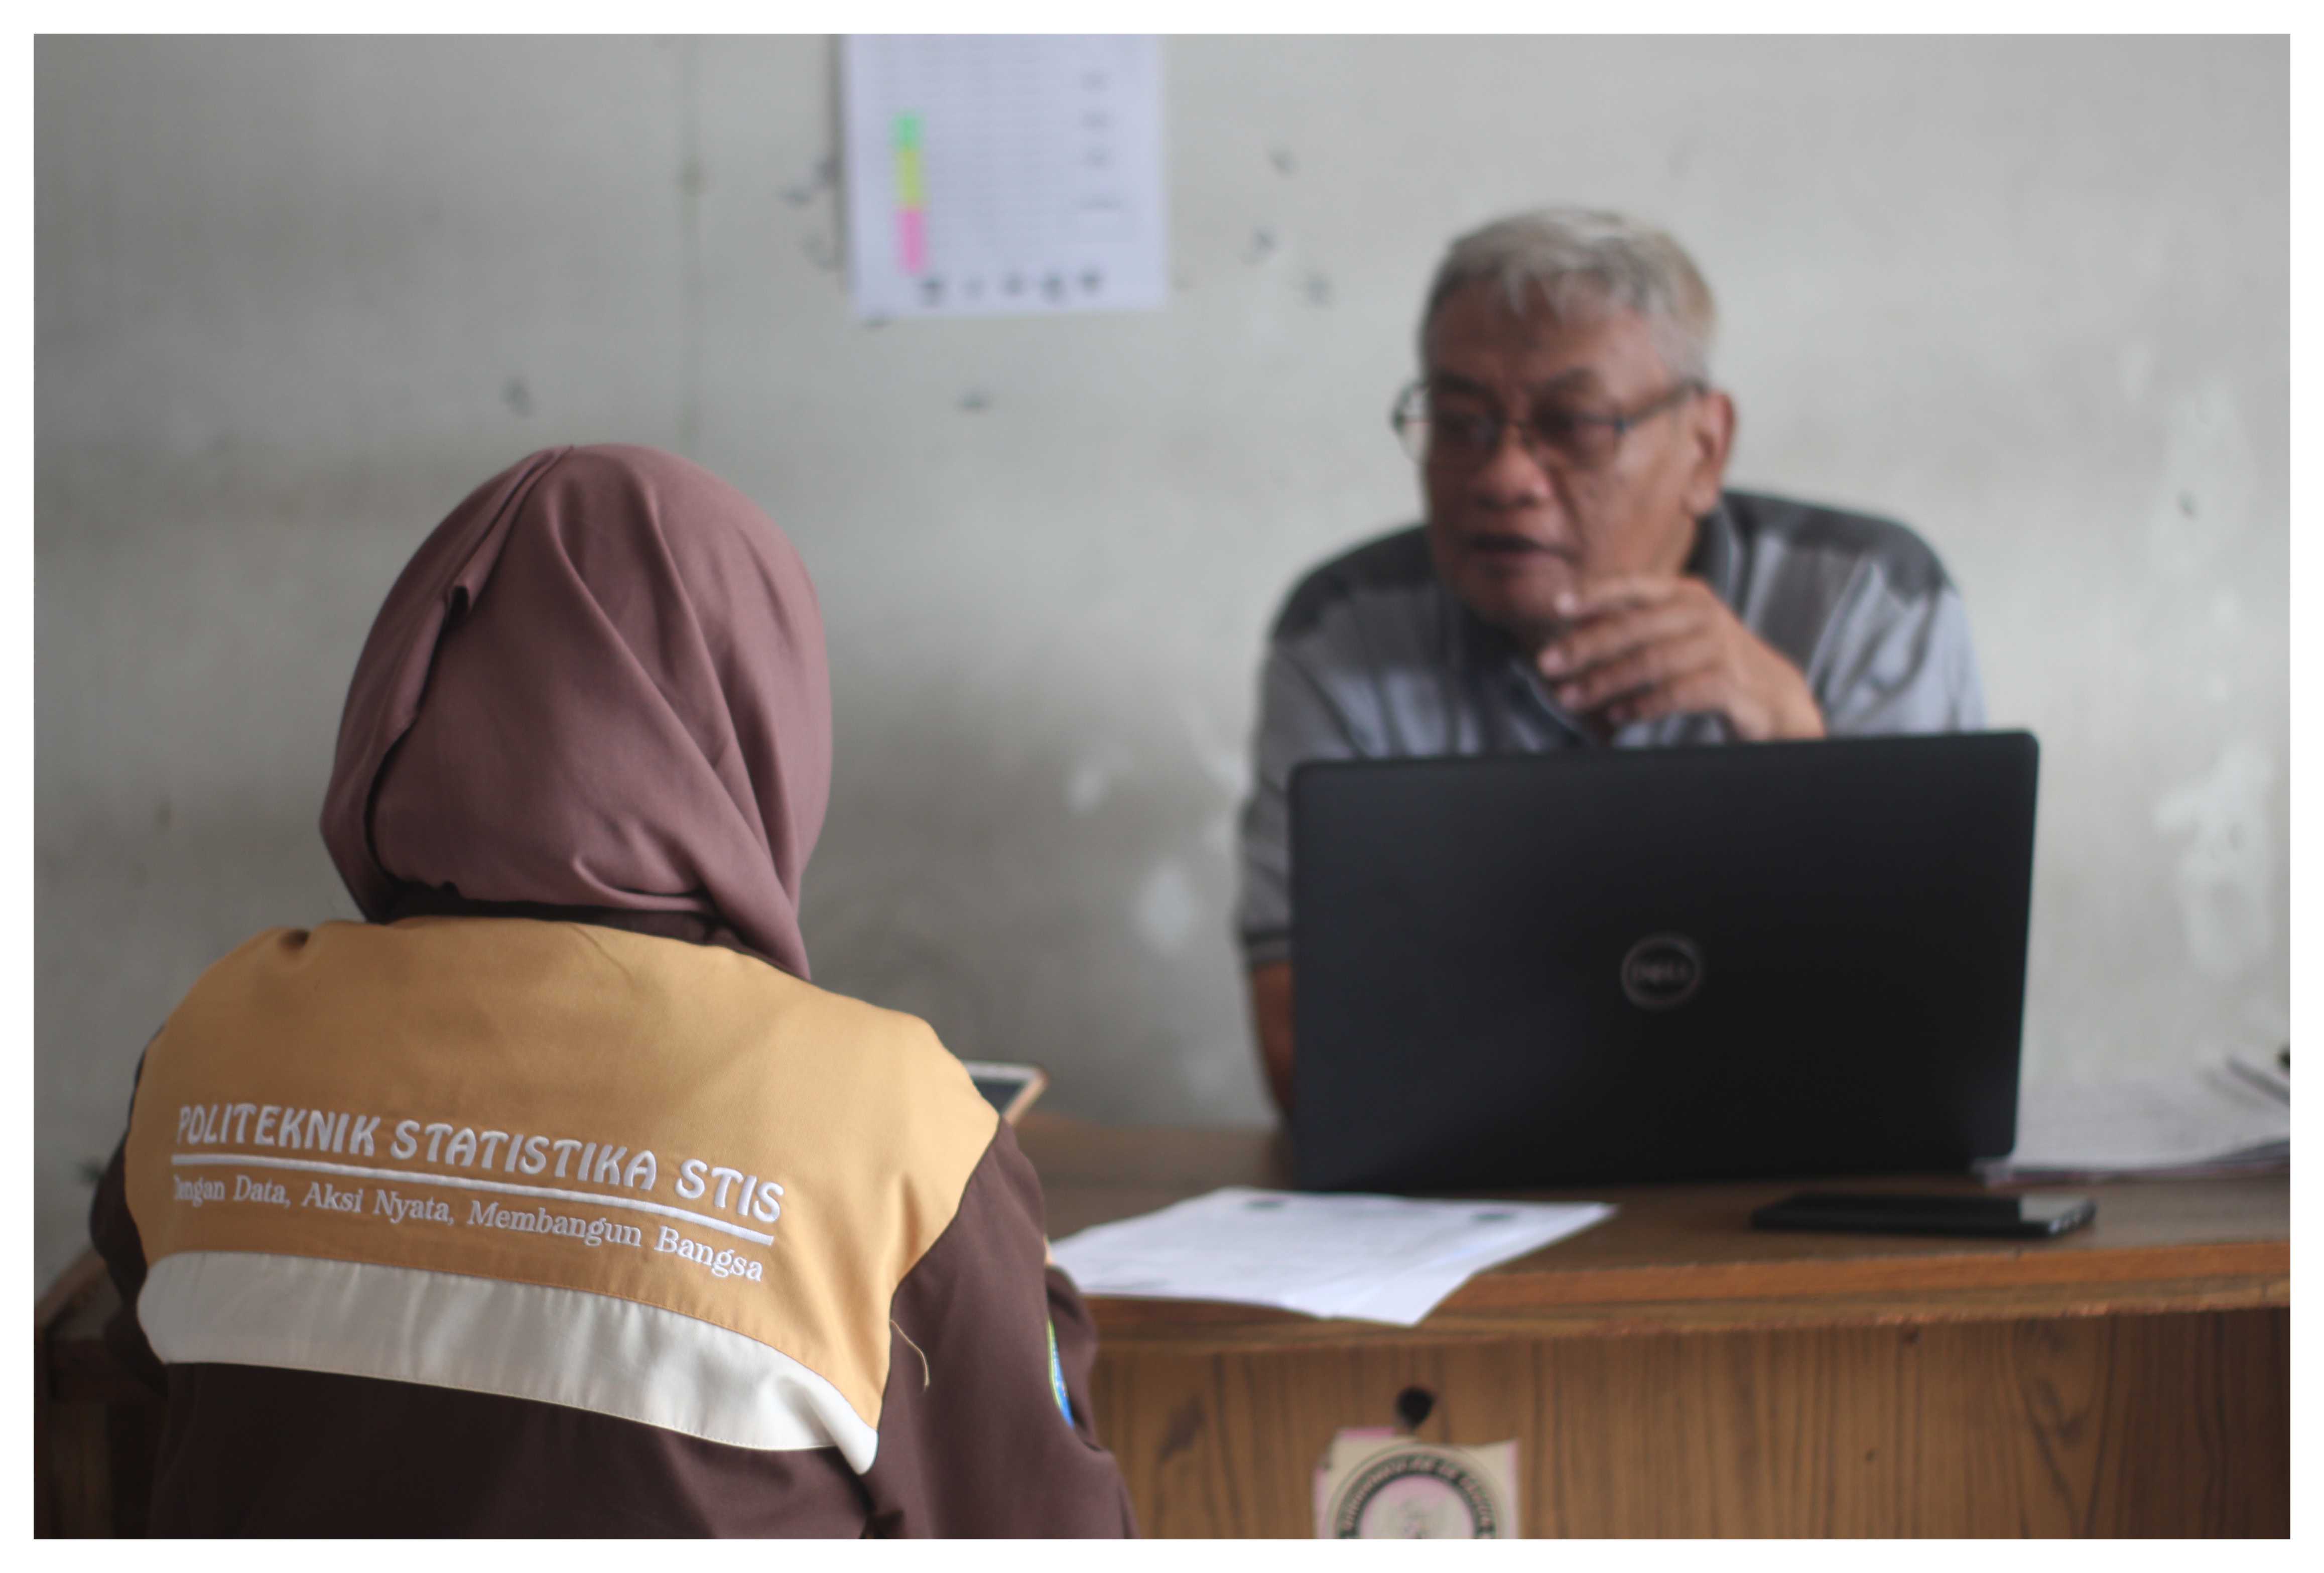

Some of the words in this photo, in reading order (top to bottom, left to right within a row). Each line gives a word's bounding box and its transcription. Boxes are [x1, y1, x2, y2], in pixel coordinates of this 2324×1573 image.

[176, 1103, 380, 1156] POLITEKNIK
[390, 1119, 658, 1191] STATISTIKA
[674, 1158, 785, 1223] STIS
[174, 1174, 226, 1207] ngan
[232, 1173, 292, 1208] Data,
[301, 1181, 364, 1214] Aksi
[373, 1188, 455, 1225] Nyata,
[467, 1200, 643, 1248] Membangun
[654, 1225, 764, 1282] Bangsa
